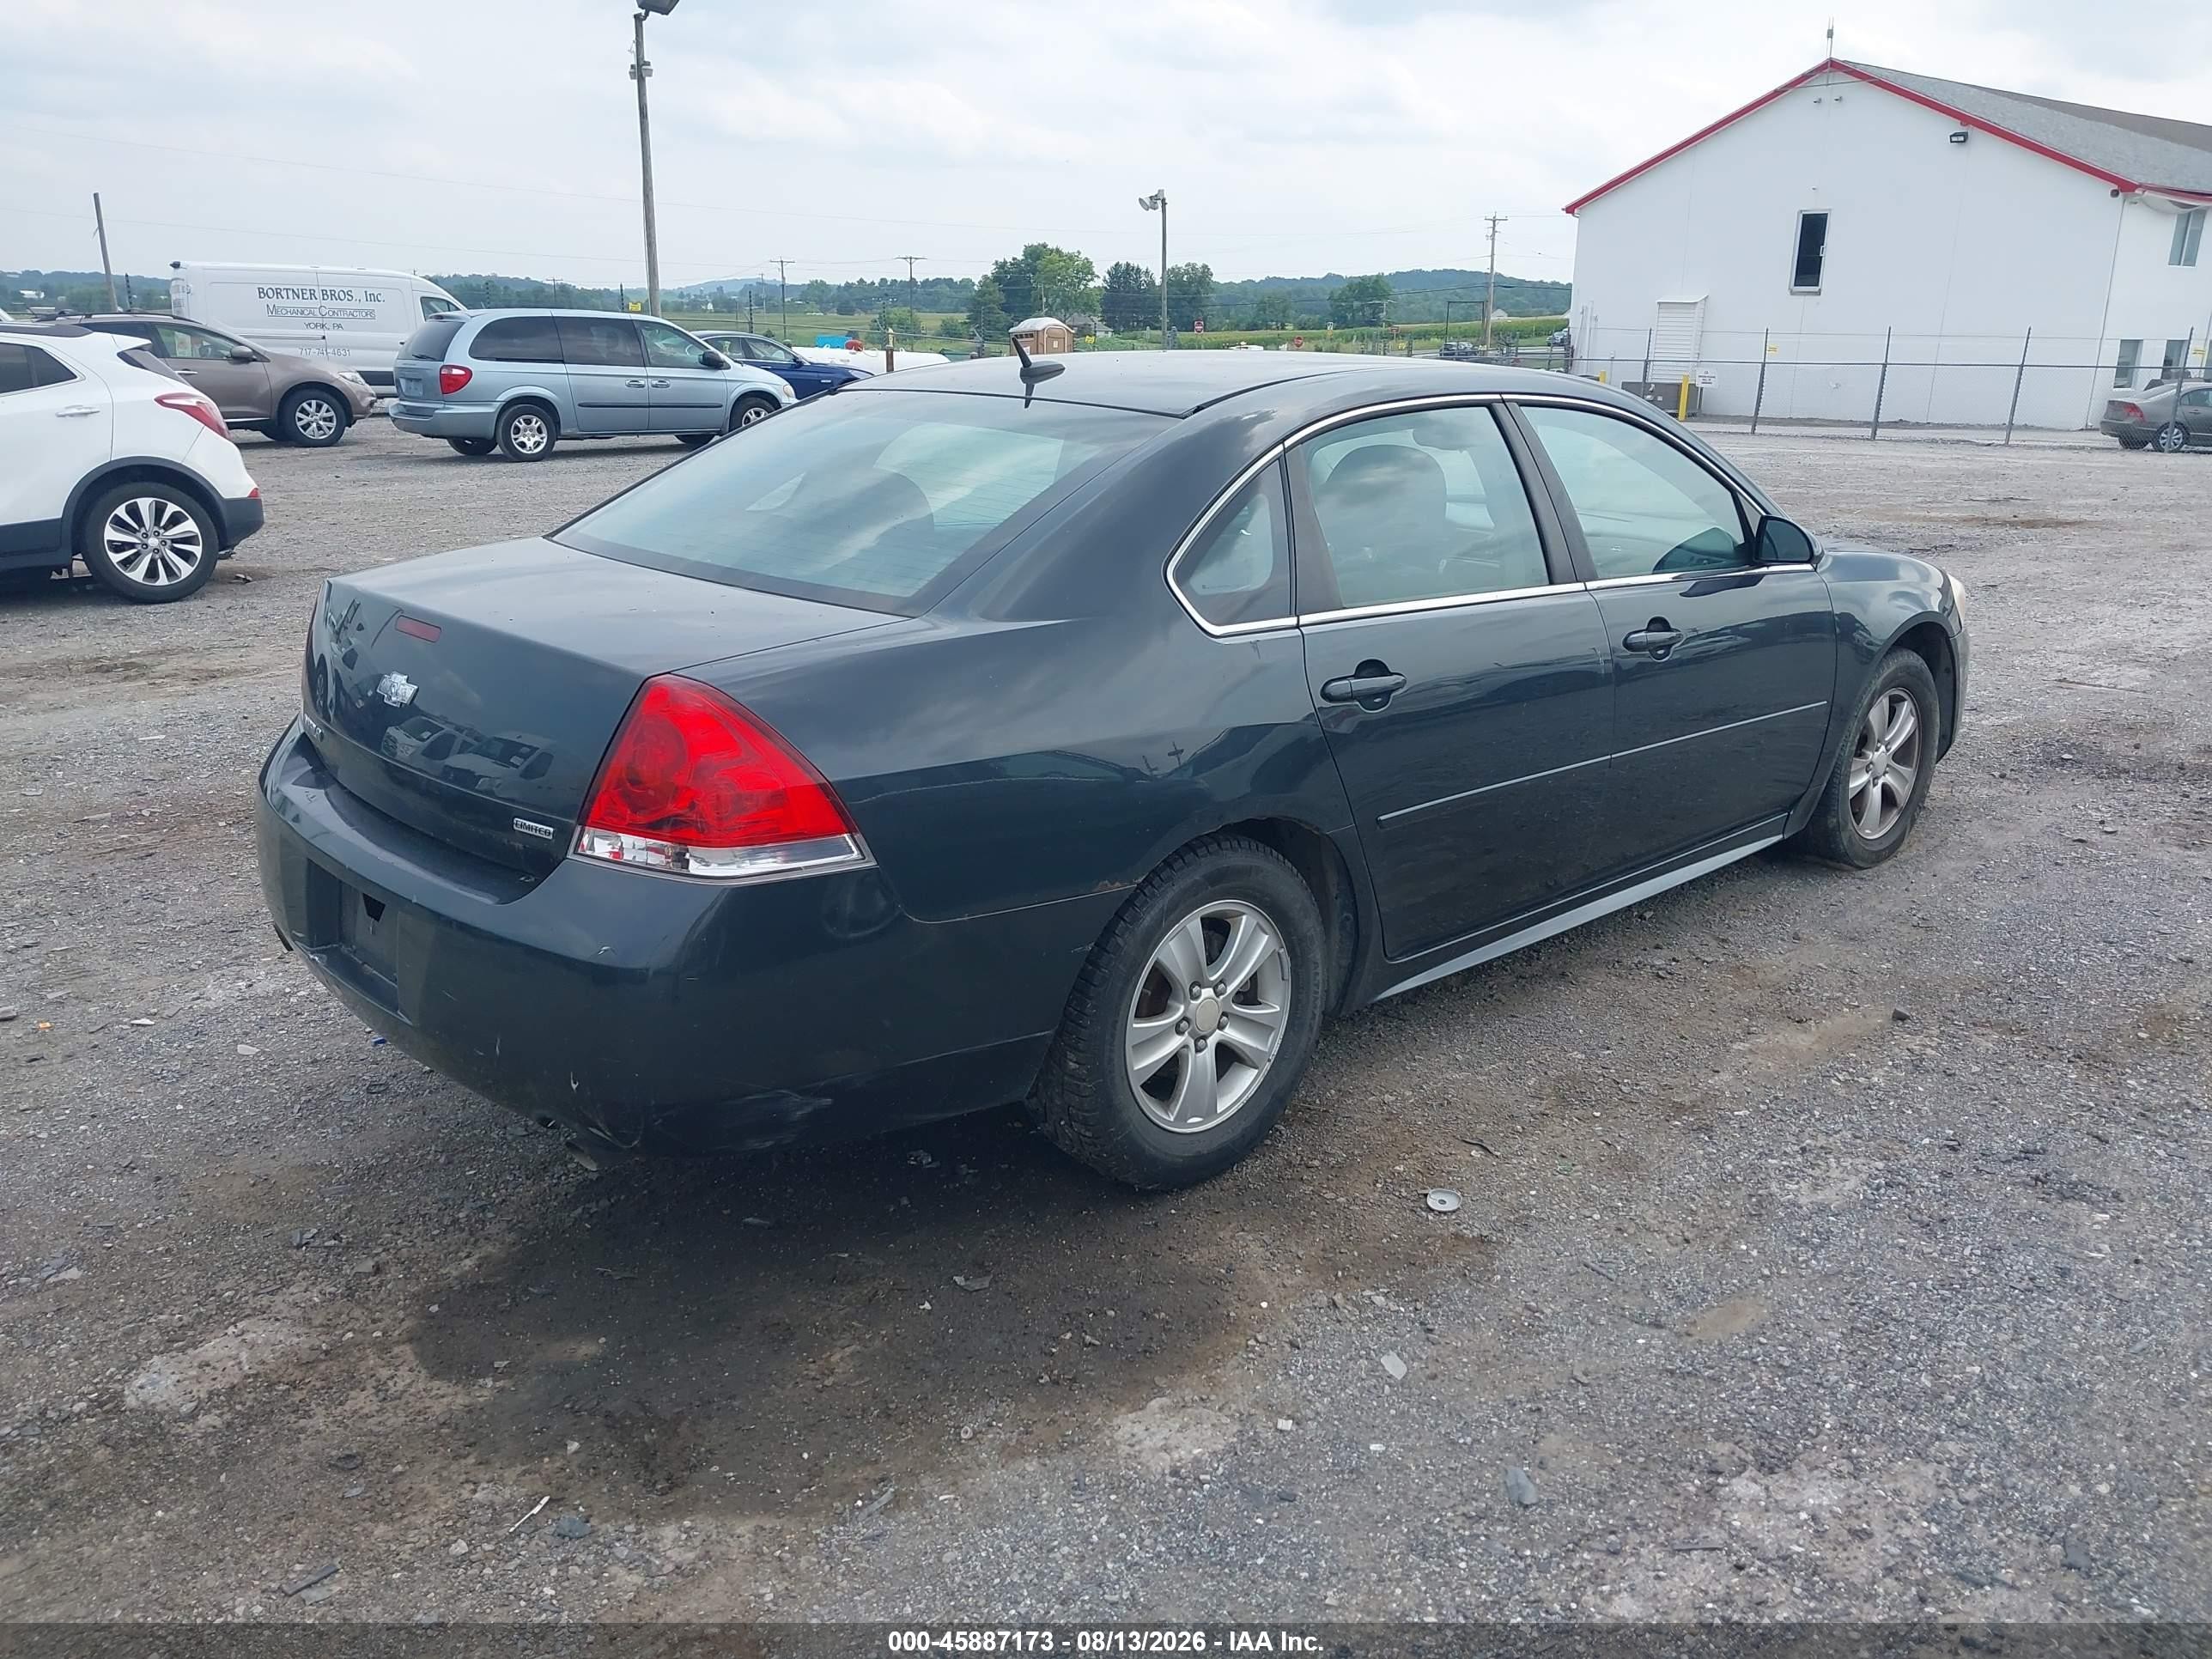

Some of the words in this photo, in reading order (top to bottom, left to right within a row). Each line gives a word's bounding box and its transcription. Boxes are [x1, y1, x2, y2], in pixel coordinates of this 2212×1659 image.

[258, 287, 318, 301] BORTNER
[321, 289, 362, 303] BROS.,
[364, 290, 385, 302] Inc.
[266, 303, 317, 316] MECHANICAL
[319, 305, 376, 318] CONTRACTORS
[299, 348, 350, 357] 717-741-4631
[514, 819, 551, 837] LIMITED
